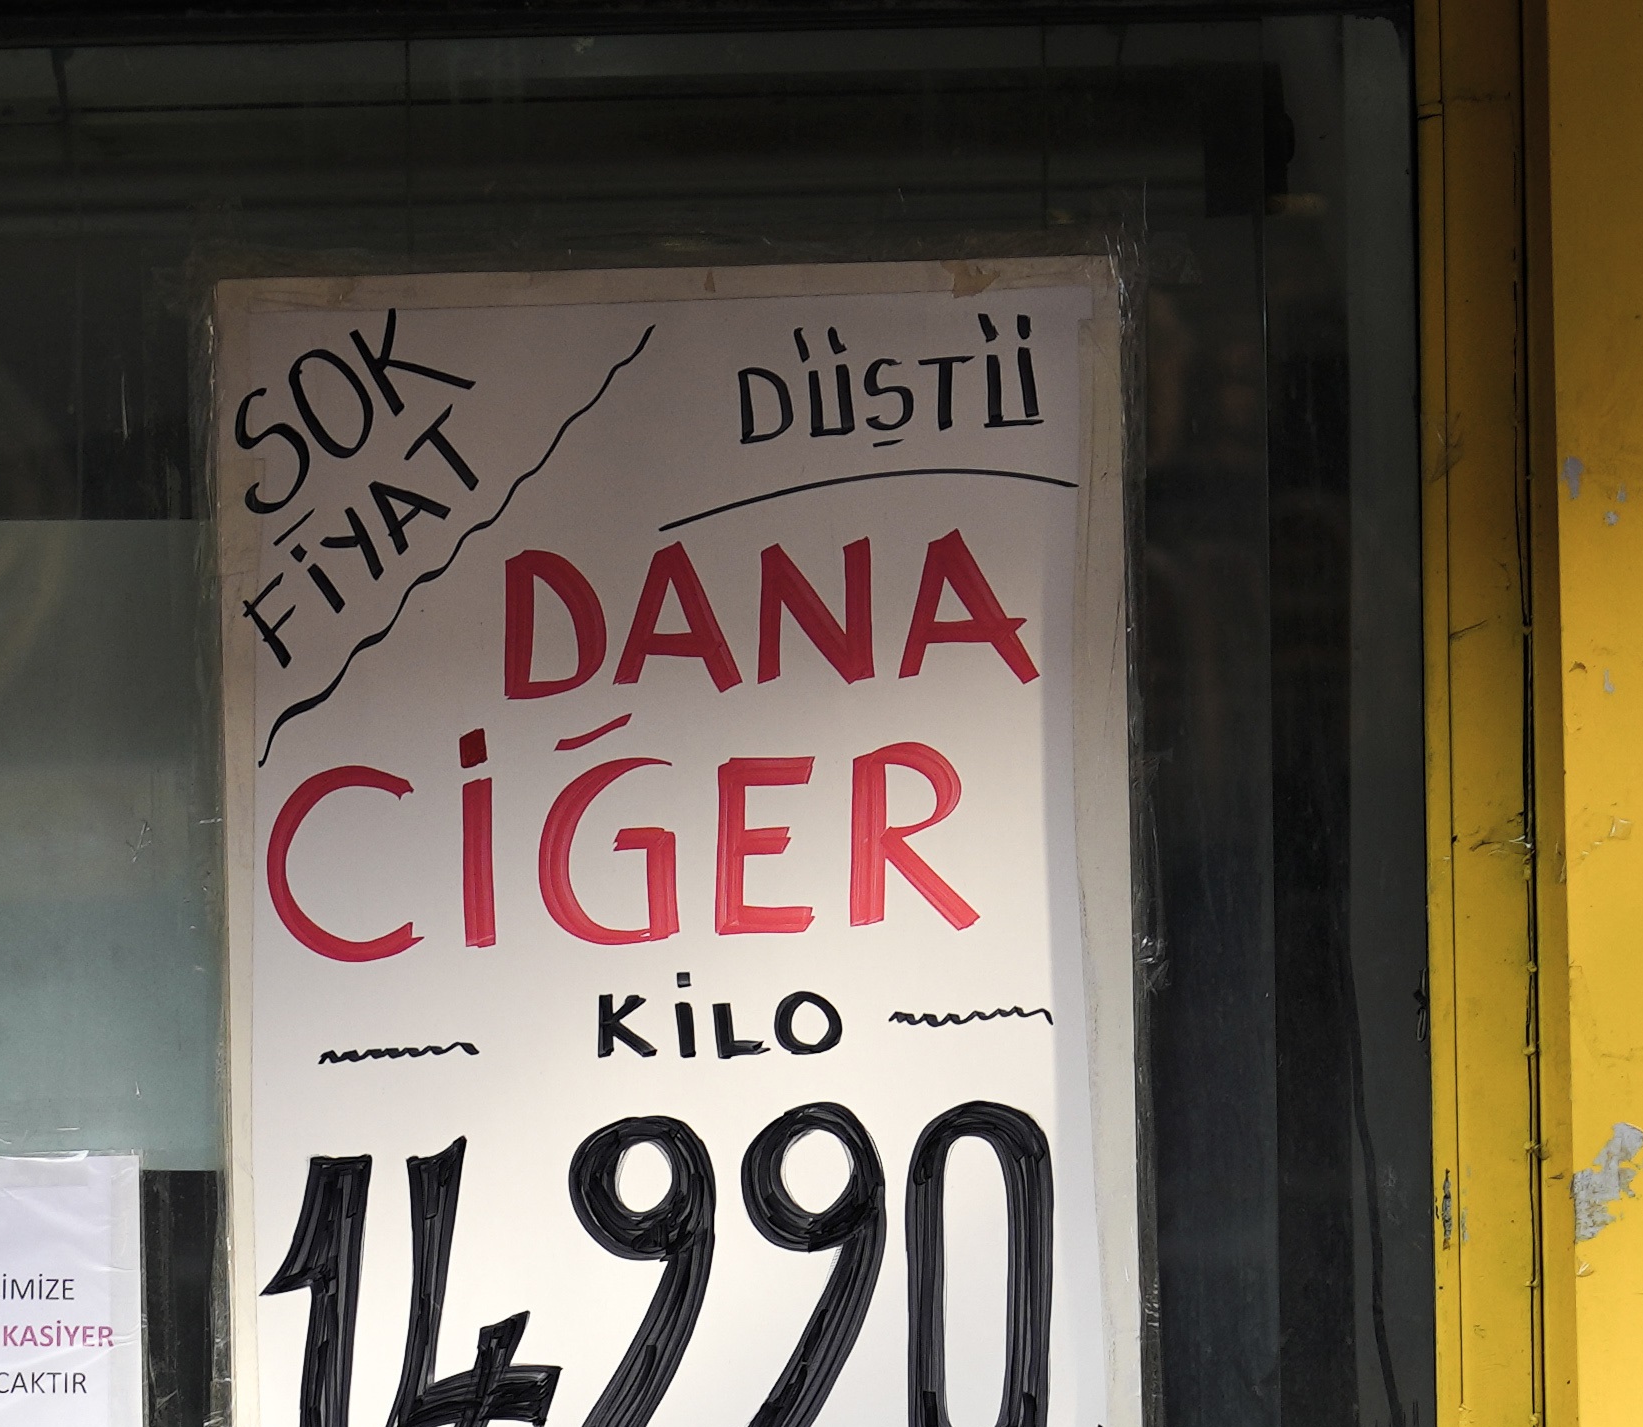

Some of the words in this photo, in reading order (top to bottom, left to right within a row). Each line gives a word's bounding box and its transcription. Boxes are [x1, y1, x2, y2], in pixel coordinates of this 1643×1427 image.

[739, 312, 1044, 450] DÜŞTÜ
[242, 403, 480, 668] FİYAT
[504, 527, 1041, 700] DANA
[265, 712, 981, 962] CİĞER
[597, 971, 843, 1060] KİLO
[2, 1319, 114, 1347] KASİYER
